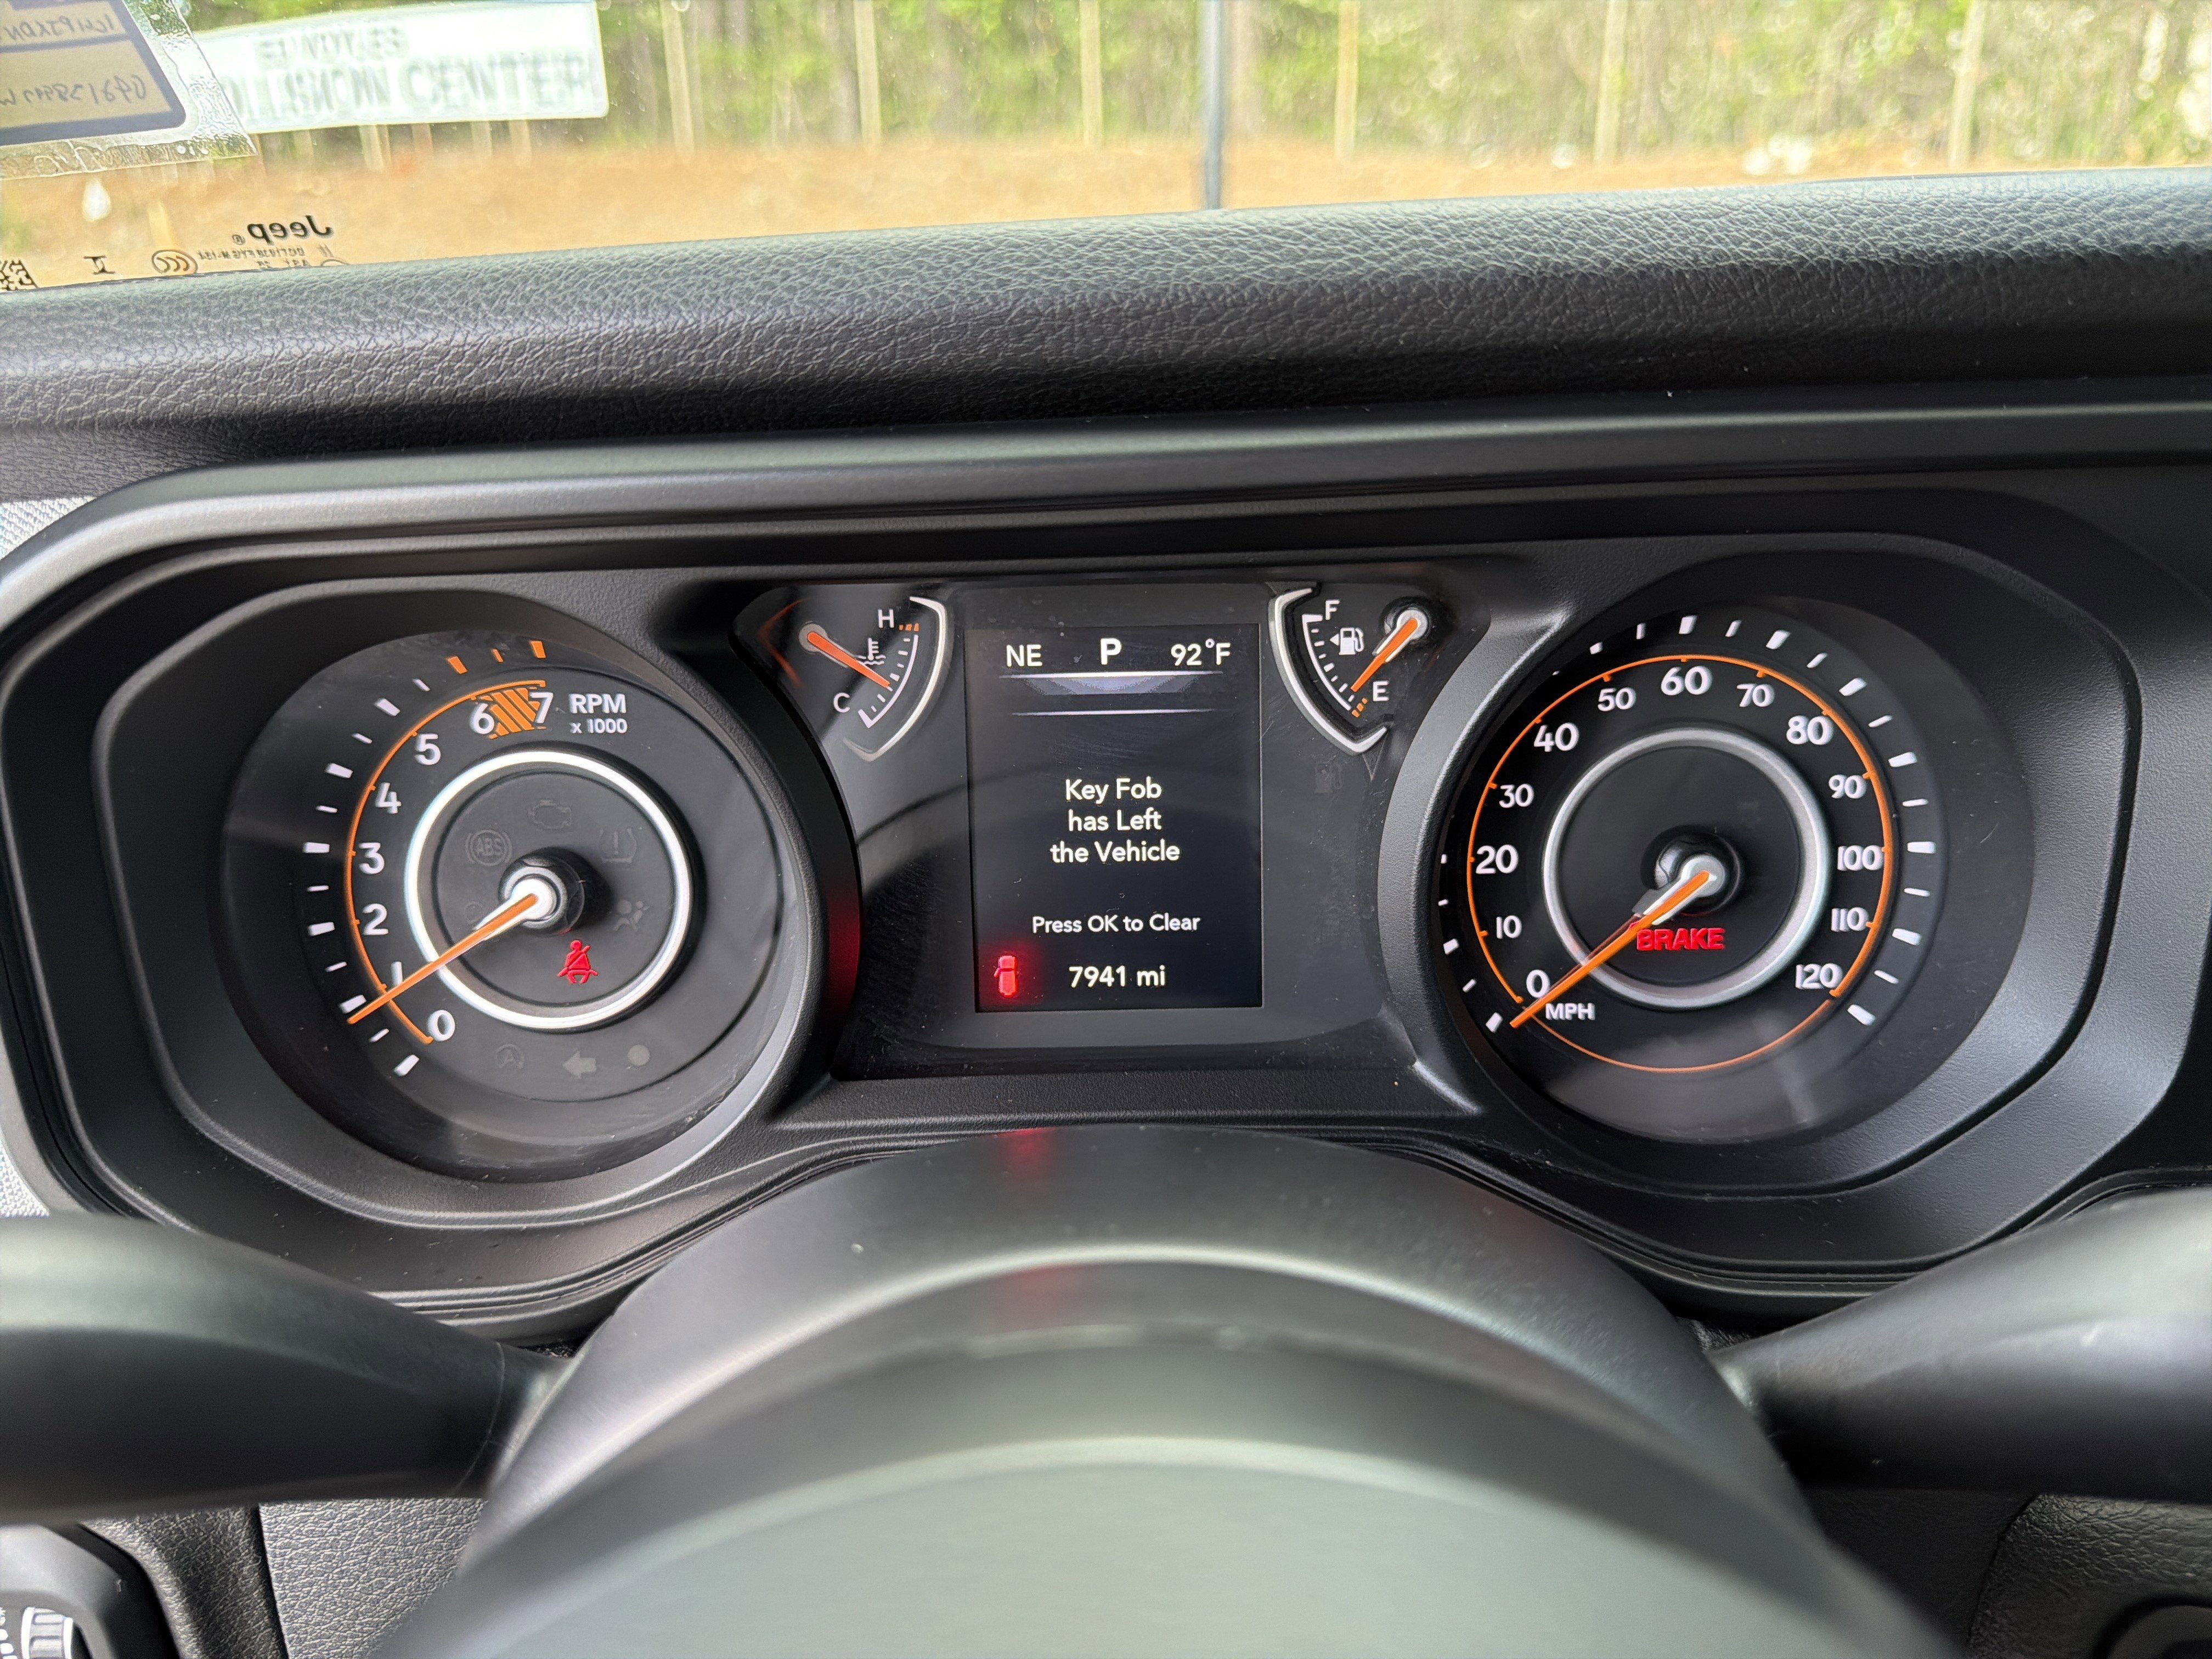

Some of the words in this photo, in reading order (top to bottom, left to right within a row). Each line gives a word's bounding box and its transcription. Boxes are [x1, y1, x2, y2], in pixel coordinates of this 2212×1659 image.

[396, 54, 595, 115] CENTER
[878, 609, 894, 628] H
[1325, 600, 1340, 620] F
[1006, 645, 1042, 667] NE
[1100, 638, 1122, 665] P
[1171, 639, 1231, 666] 92°F
[1373, 680, 1390, 702] E
[1660, 665, 1713, 696] 60
[529, 692, 554, 724] 7
[568, 693, 627, 714] RPM
[833, 692, 850, 713] C
[1597, 687, 1637, 712] 50
[1736, 682, 1775, 708] 70
[469, 703, 495, 735] 6
[586, 718, 628, 733] 1000
[1786, 714, 1834, 746] 80
[414, 733, 441, 765] 5
[1533, 722, 1580, 753] 40
[375, 782, 402, 814] 4
[1065, 778, 1108, 804] Key
[1116, 777, 1163, 800] Fob
[1498, 783, 1534, 809] 30
[1828, 774, 1866, 799] 90
[1068, 809, 1109, 832] has
[1117, 808, 1162, 831] Left
[358, 842, 385, 874] 3
[1051, 841, 1089, 863] the
[1094, 839, 1181, 862] Vehicle
[1475, 844, 1519, 874] 20
[1837, 845, 1884, 872] 100
[363, 902, 389, 935] 2
[1032, 916, 1082, 933] Press
[1088, 915, 1118, 933] OK
[1124, 916, 1143, 932] to
[1149, 913, 1200, 931] Clear
[1496, 916, 1522, 939] 10
[1831, 908, 1867, 932] 110
[1635, 927, 1725, 951] BRAKE
[391, 961, 403, 986] 1
[1069, 966, 1126, 988] 7941
[1137, 964, 1166, 987] mi
[1526, 969, 1551, 998] 0
[1795, 963, 1843, 990] 120
[427, 1009, 455, 1041] 0
[1545, 1003, 1595, 1021] MPH
